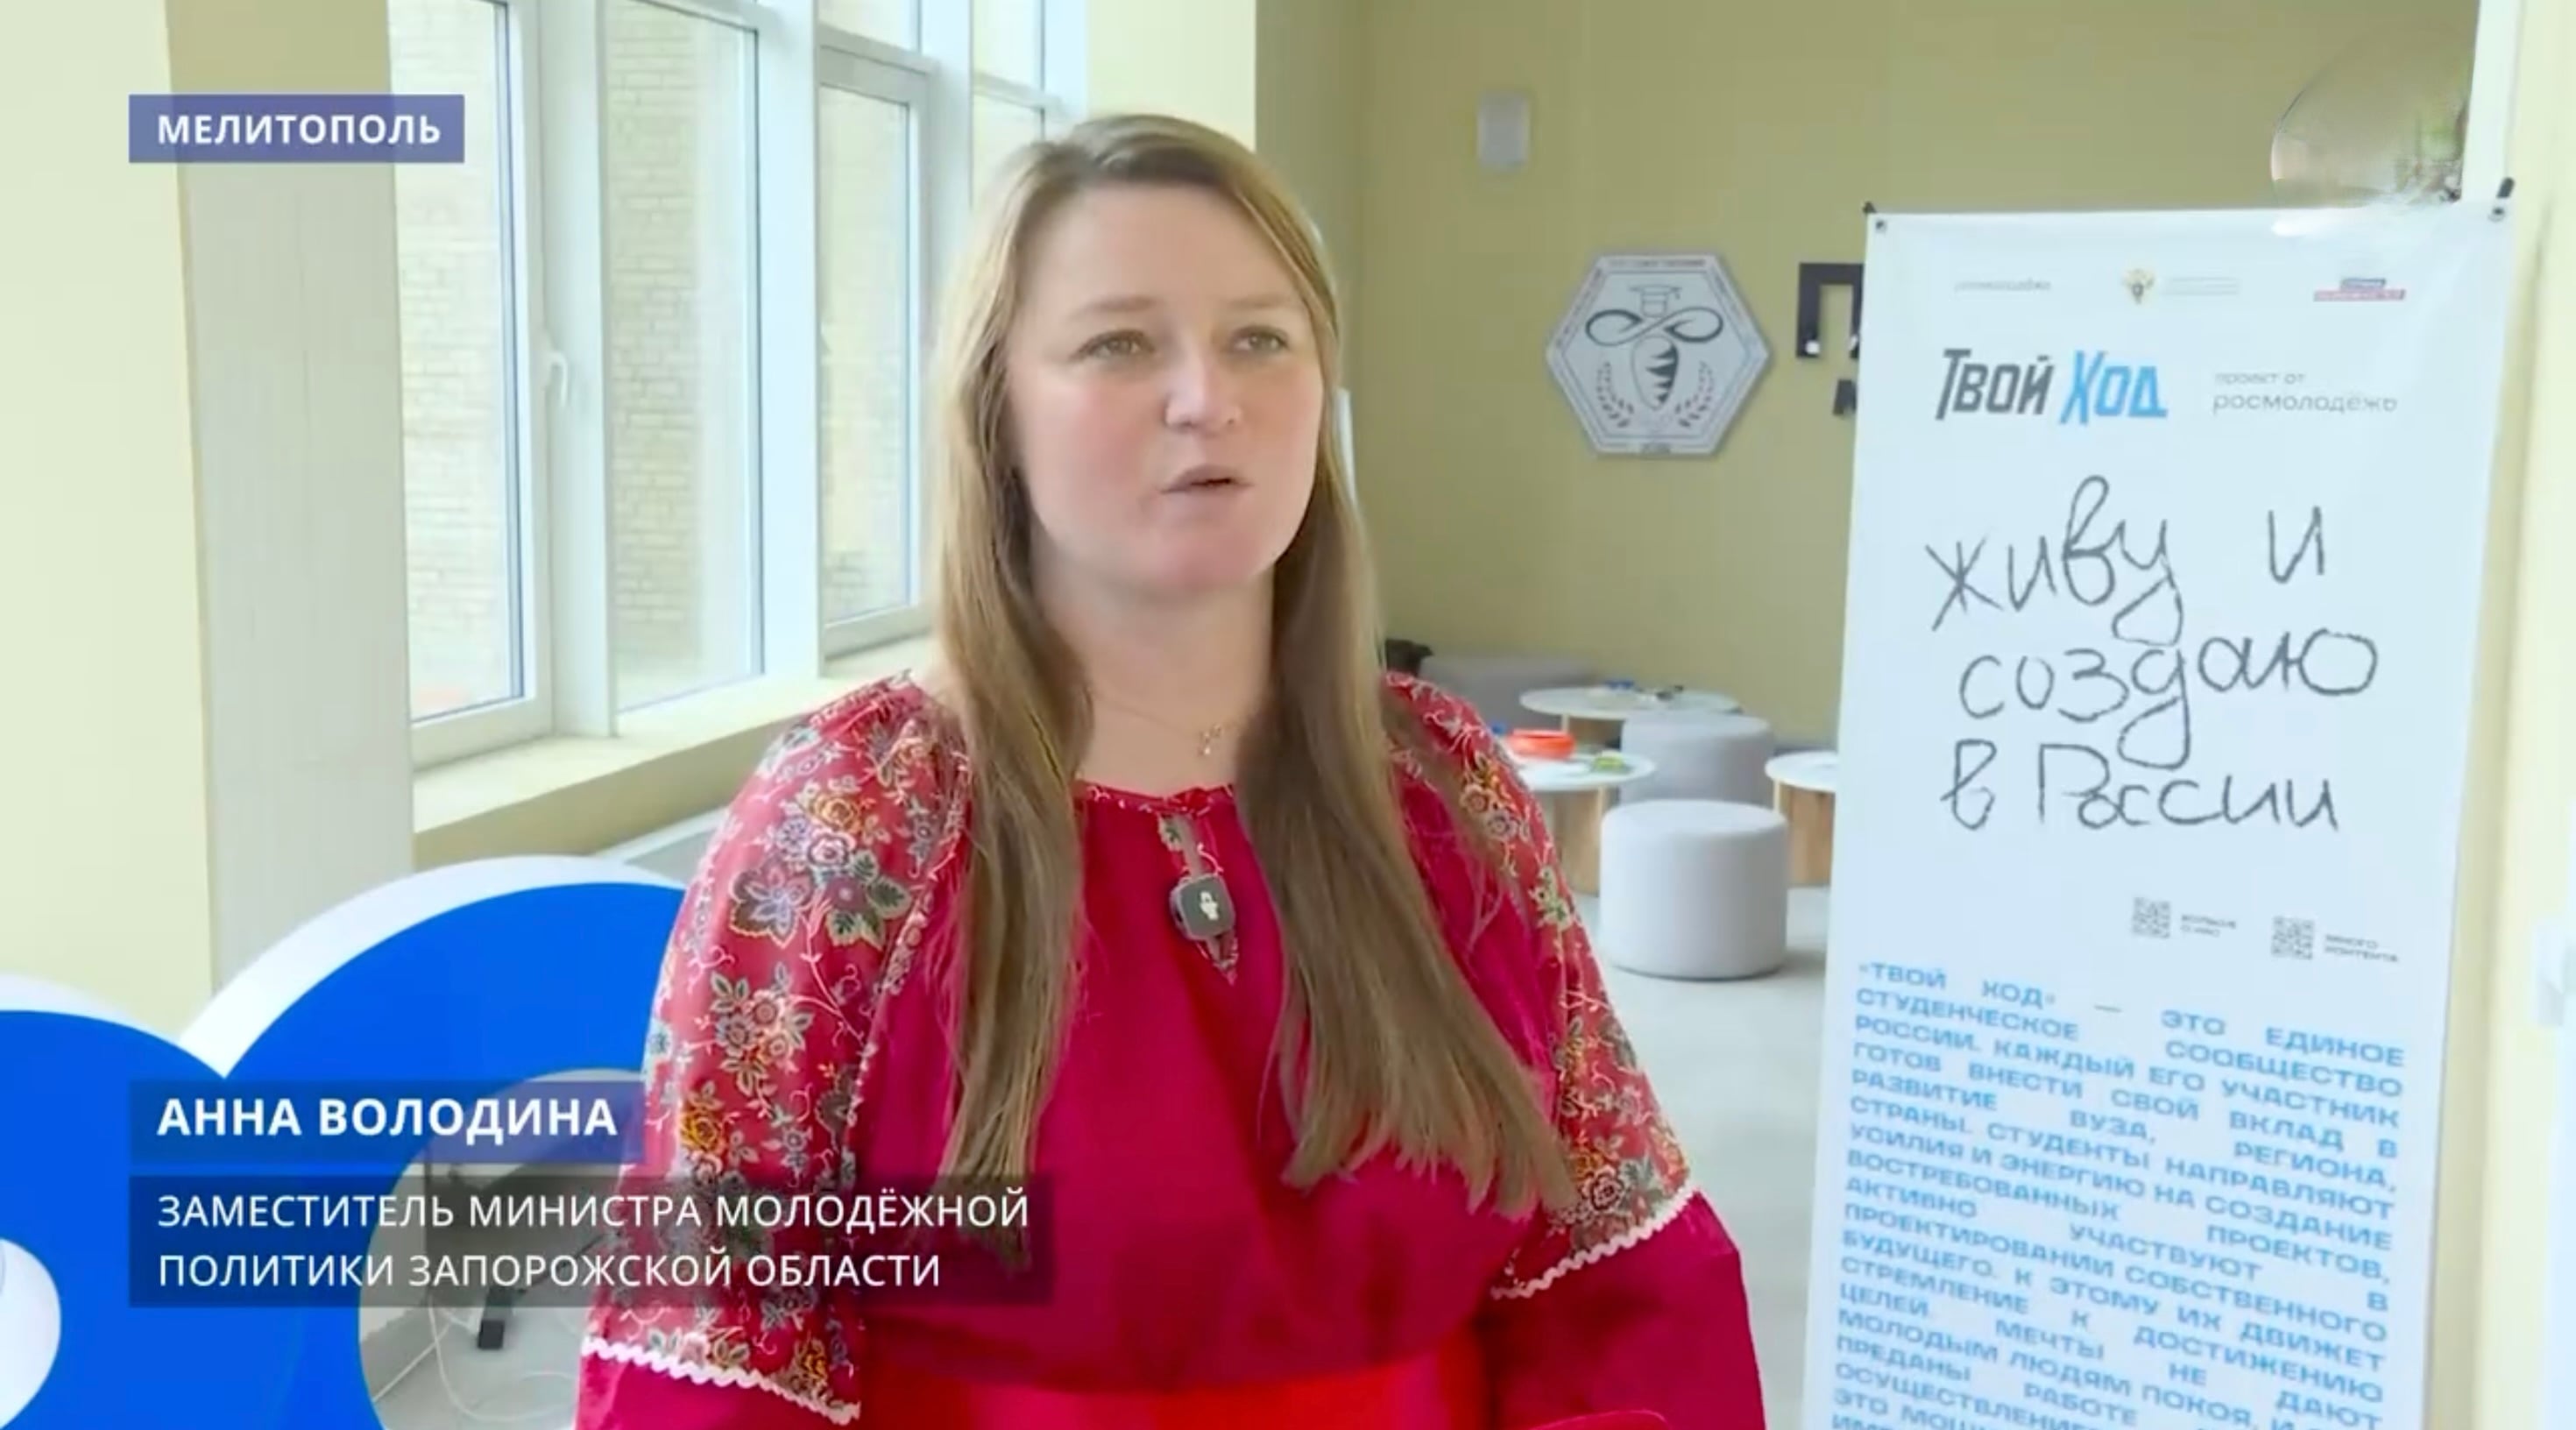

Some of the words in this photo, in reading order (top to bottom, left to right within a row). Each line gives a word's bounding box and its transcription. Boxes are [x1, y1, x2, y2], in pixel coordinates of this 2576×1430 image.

[1925, 474, 2184, 647] живу
[1959, 627, 2378, 770] создаю
[1939, 738, 1998, 831] в
[2038, 742, 2339, 832] России
[1855, 1015, 1982, 1051] РОССИИ.
[1993, 1037, 2135, 1080] КАЖДЫЙ
[2148, 1065, 2205, 1092] ЕГО
[2221, 1079, 2399, 1129] УЧАСТНИК
[1856, 988, 2079, 1041] СТУДЕНЧЕСКОЕ
[2165, 1040, 2403, 1096] СООБЩЕСТВО
[2161, 1009, 2227, 1036] ЭТО
[2265, 1026, 2404, 1067] ЕДИНОЕ
[1852, 1068, 1998, 1111] РАЗВИТИЕ
[2070, 1109, 2156, 1144] ВУЗА,
[2233, 1141, 2397, 1193] РЕГИОНА,
[1853, 1042, 1942, 1072] ГОТОВ
[1968, 1061, 2084, 1099] ВНЕСТИ
[2111, 1088, 2199, 1122] СВОЙ
[2228, 1110, 2344, 1151] ВКЛАД
[2378, 1138, 2397, 1158] В
[1847, 1149, 2120, 1221] ВОСТРЕБОВАННЫХ
[2207, 1225, 2390, 1285] ПРОЕКТОВ,
[1849, 1122, 1964, 1159] УСИЛИЯ
[1971, 1147, 1992, 1166] И
[2000, 1153, 2145, 1198] ЭНЕРГИЮ
[2154, 1185, 2196, 1209] НА
[2205, 1195, 2393, 1251] СОЗДАНИЕ
[1987, 1122, 2149, 1170] СТУДЕНТЫ
[2165, 1157, 2396, 1220] НАПРАВЛЯЮТ
[1845, 1176, 1978, 1219] АКТИВНО
[2069, 1222, 2263, 1281] УЧАСТВУЮТ
[2367, 1292, 2388, 1313] В
[1845, 1203, 2114, 1278] ПРОЕКТИРОВАНИИ
[2125, 1265, 2388, 1342] СОБСТВЕННОГО
[1838, 1308, 1999, 1364] МОЛОДЫМ
[2009, 1350, 2132, 1398] ЛЮДЯМ
[1841, 1256, 2029, 1314] СТРЕМЛЕНИЕ
[2071, 1310, 2091, 1331] К
[2134, 1325, 2383, 1404] ДОСТИЖЕНИЮ
[1996, 1319, 2105, 1360] МЕЧТЫ
[2169, 1362, 2207, 1386] НЕ
[2275, 1390, 2383, 1430] ДАЮТ
[2014, 1269, 2032, 1287] К
[2049, 1277, 2159, 1316] ЭТОМУ
[2177, 1306, 2221, 1332] ИХ
[2239, 1320, 2386, 1372] ДВИЖЕТ
[1834, 1388, 1889, 1415] ЭТО
[1836, 1334, 1971, 1383] ПРЕДАНЫ
[2024, 1382, 2138, 1426] РАБОТЕ
